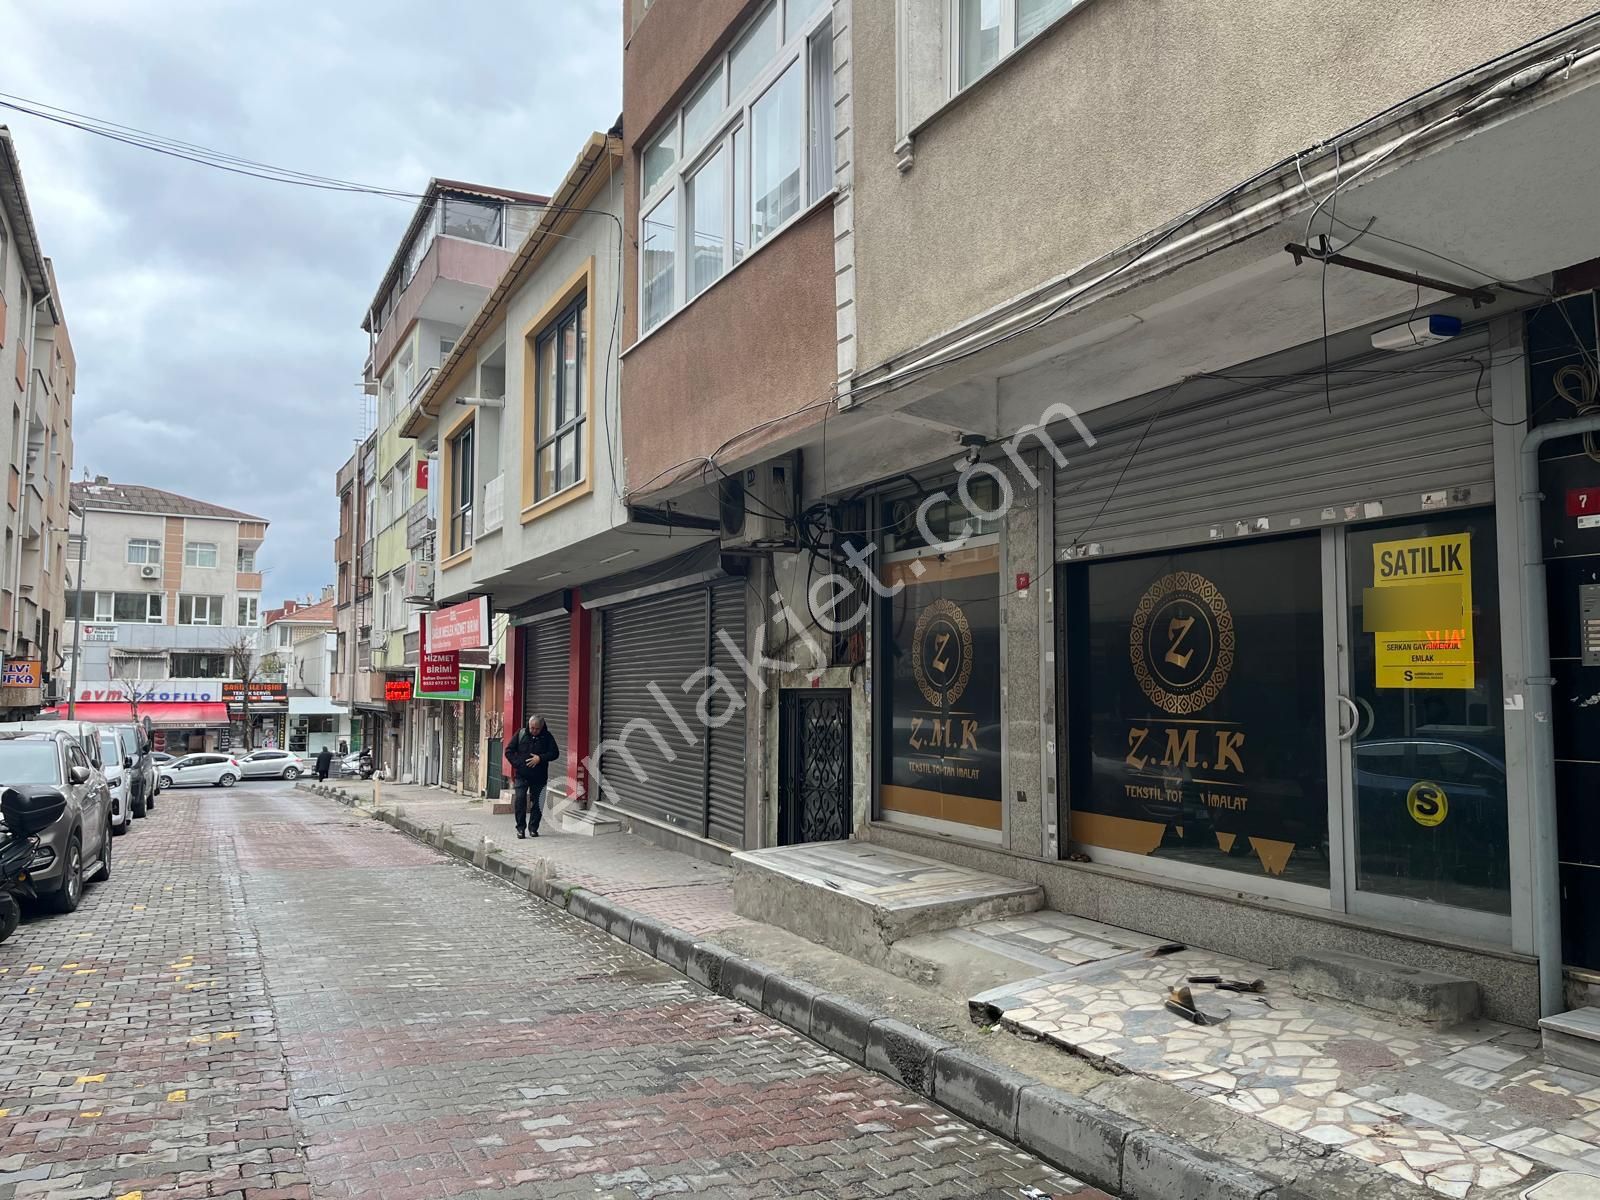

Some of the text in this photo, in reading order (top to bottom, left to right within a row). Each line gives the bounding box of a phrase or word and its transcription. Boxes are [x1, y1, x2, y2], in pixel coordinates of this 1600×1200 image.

[1380, 543, 1463, 577] SATILIK
[932, 632, 951, 673] Z
[1165, 615, 1196, 669] Z
[1386, 643, 1412, 651] SERKAN
[424, 653, 455, 662] HİZMET
[426, 664, 452, 674] BİRİMİ
[1411, 654, 1434, 662] EMLAK
[1126, 727, 1246, 774] Z.M.K
[1125, 784, 1164, 802] TEKSTİL
[1207, 790, 1248, 811] İMALAT
